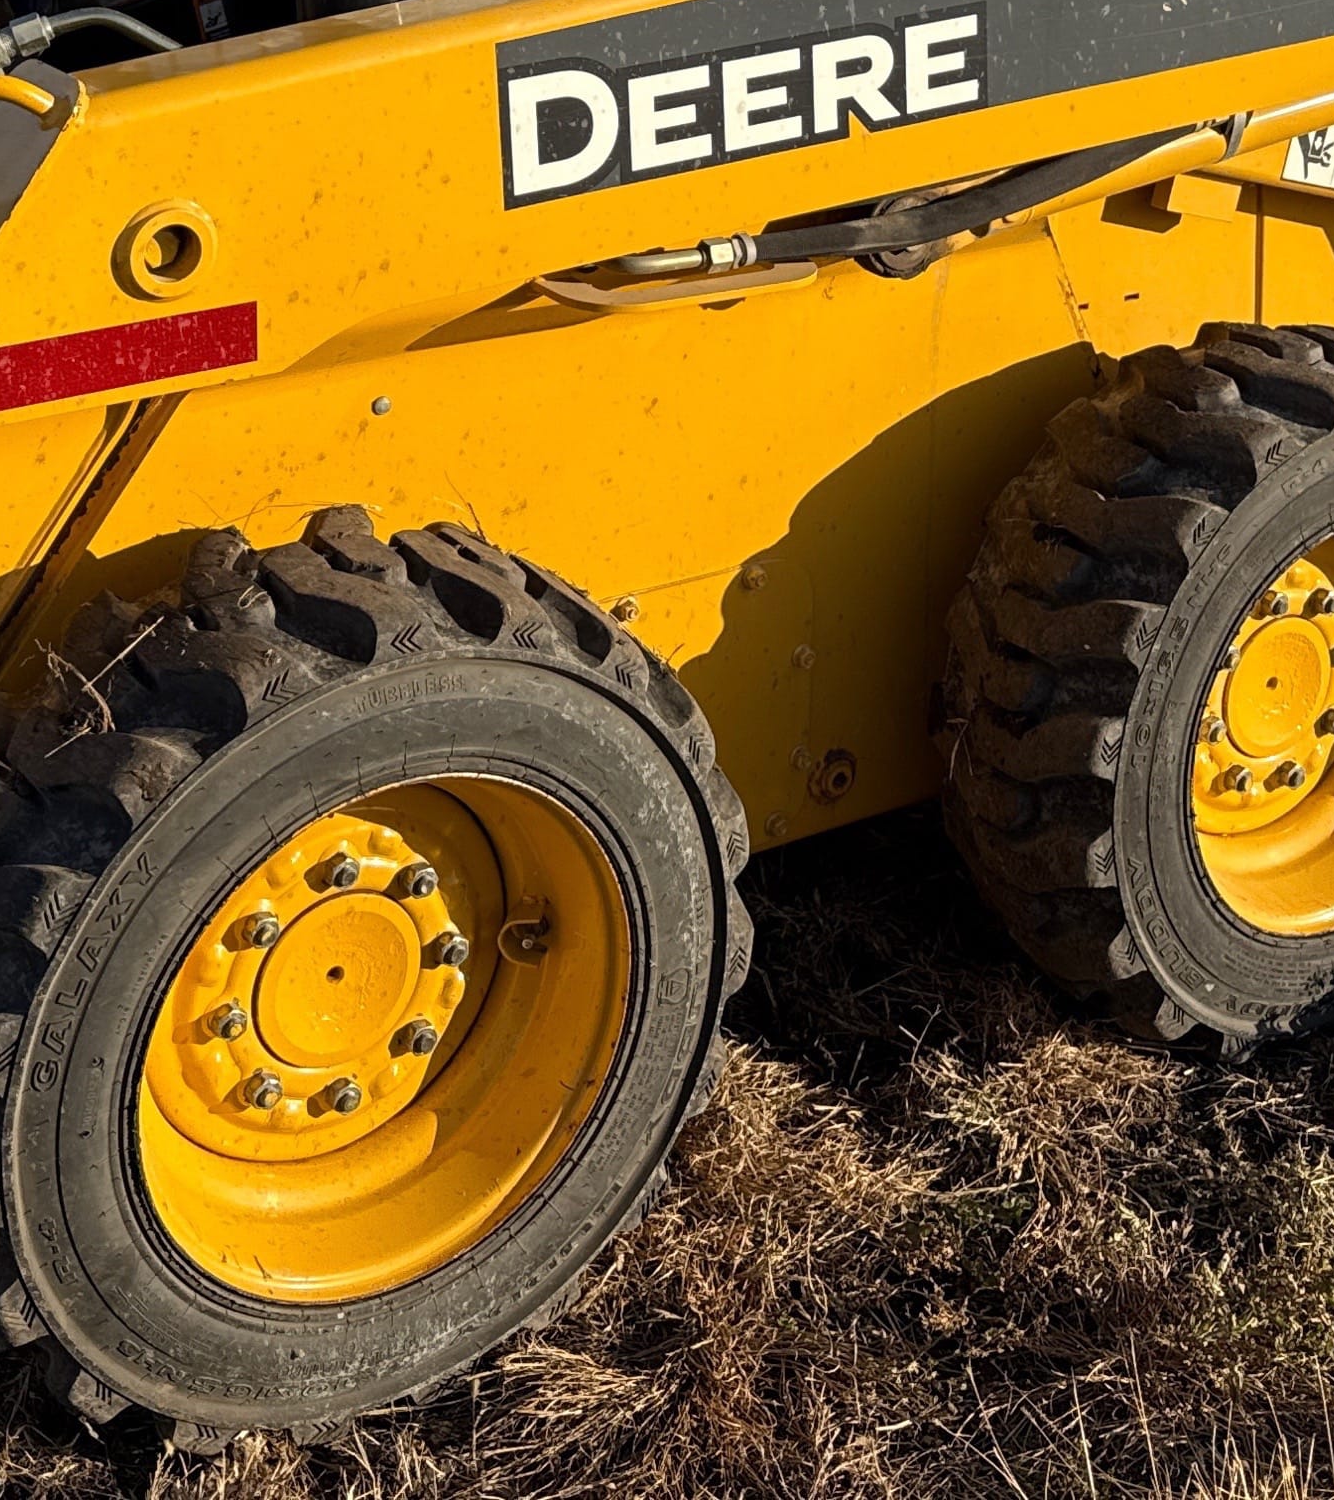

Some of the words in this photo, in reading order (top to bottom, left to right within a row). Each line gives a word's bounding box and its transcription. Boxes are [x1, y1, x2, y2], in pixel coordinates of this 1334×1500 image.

[508, 14, 978, 195] DEERE
[353, 674, 467, 714] TUBELESS
[30, 851, 158, 1093] GALAXY
[1126, 856, 1207, 993] BUDDY
